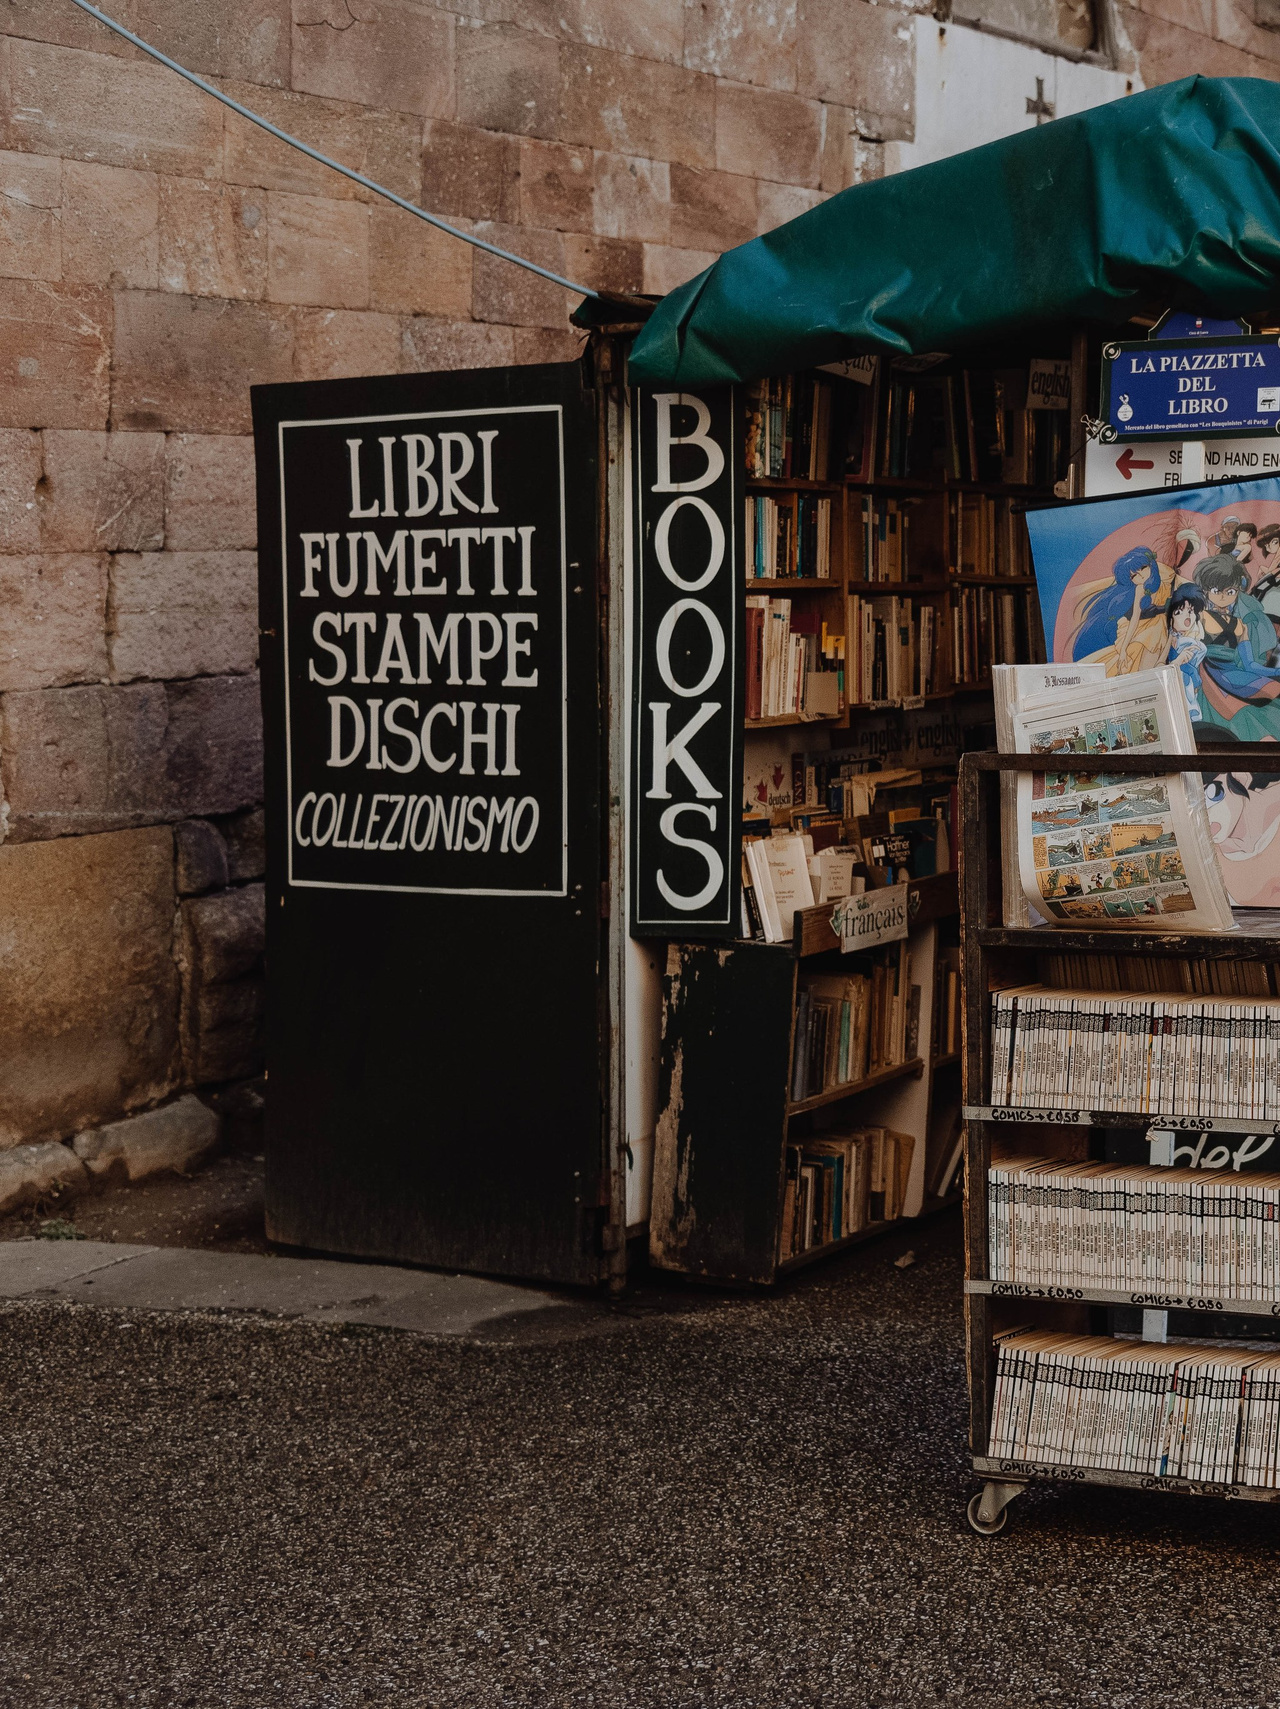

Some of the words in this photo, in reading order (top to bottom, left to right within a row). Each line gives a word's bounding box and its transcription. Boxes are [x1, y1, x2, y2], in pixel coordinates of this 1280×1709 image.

[1130, 358, 1155, 374] LA
[1160, 352, 1266, 372] PIAZZETTA
[1031, 362, 1070, 404] english
[1177, 376, 1216, 393] DEL
[1168, 397, 1228, 416] LIBRO
[1166, 422, 1189, 431] gemellato
[1169, 450, 1221, 465] SEND
[1224, 453, 1259, 467] HAND
[346, 430, 499, 518] LIBRI
[300, 526, 538, 597] FUMETTI
[308, 611, 539, 687] STAMPE
[646, 392, 726, 912] BOOKS
[326, 696, 521, 776] DISCHI
[768, 791, 792, 806] deutsch
[295, 791, 540, 854] COLLEZIONISMO
[844, 897, 906, 940] français
[991, 1108, 1035, 1122] COMICS
[1179, 1118, 1213, 1130] €0,50
[991, 1284, 1033, 1296] COMICS
[1047, 1287, 1083, 1299] €0,50
[1131, 1293, 1172, 1305] COMICS
[1187, 1297, 1224, 1310] €0,50
[999, 1459, 1038, 1475] COMICS
[1051, 1466, 1086, 1480] €0,50
